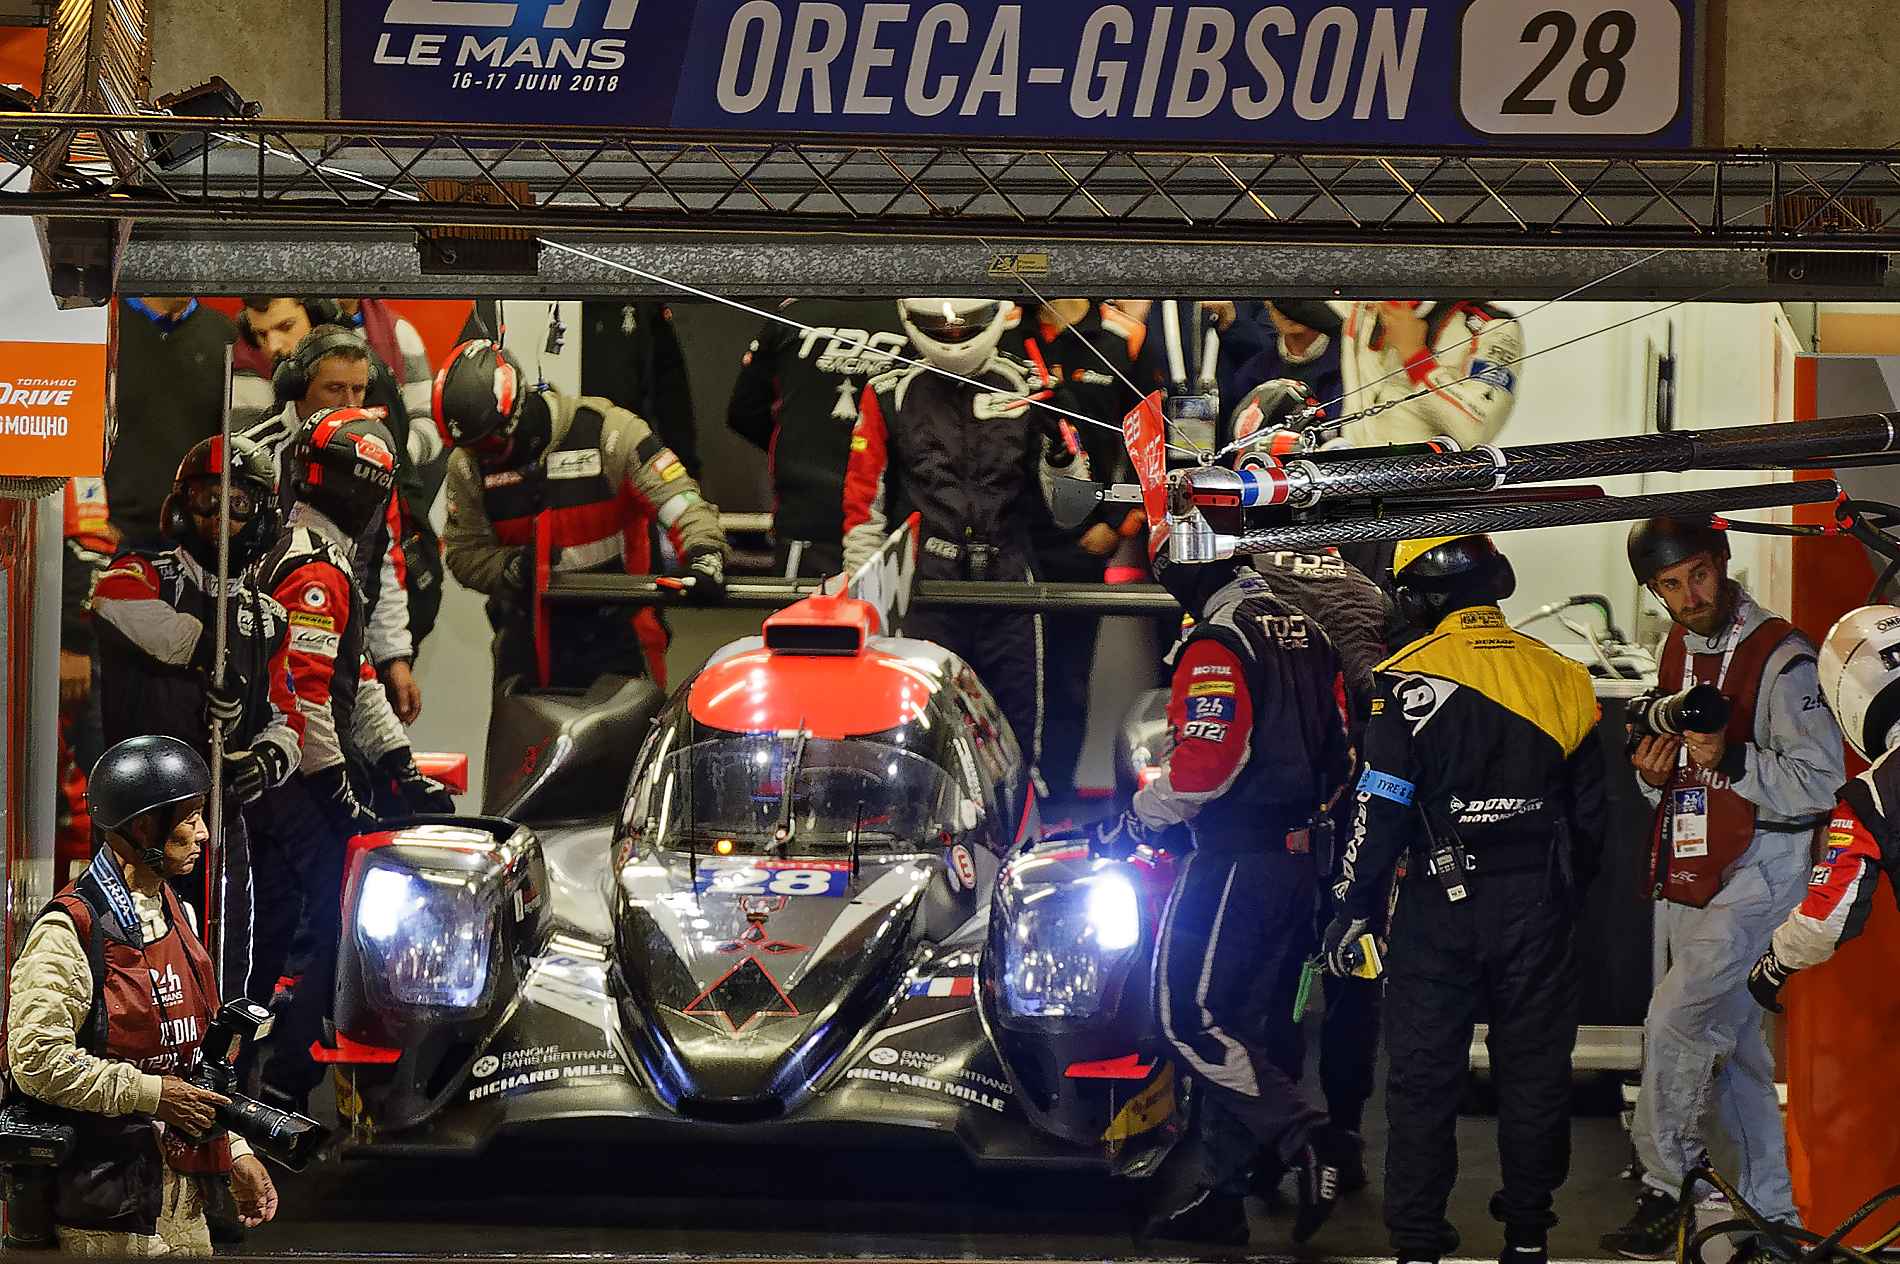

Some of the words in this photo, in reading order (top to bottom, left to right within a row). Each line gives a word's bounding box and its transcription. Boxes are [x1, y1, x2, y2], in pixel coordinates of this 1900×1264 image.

[373, 33, 447, 66] LE
[455, 35, 626, 70] MANS
[716, 0, 1428, 121] ORECA-GIBSON
[1500, 10, 1637, 116] 28
[451, 72, 506, 90] 16-17
[515, 74, 562, 91] JUIN
[569, 75, 619, 92] 2018
[0, 415, 68, 439] МОЩНО
[705, 868, 832, 896] 28
[469, 1068, 560, 1101] RICHARD
[563, 1063, 626, 1078] MILLE
[846, 1068, 942, 1092] RICHARD
[945, 1082, 1006, 1113] MILLE
